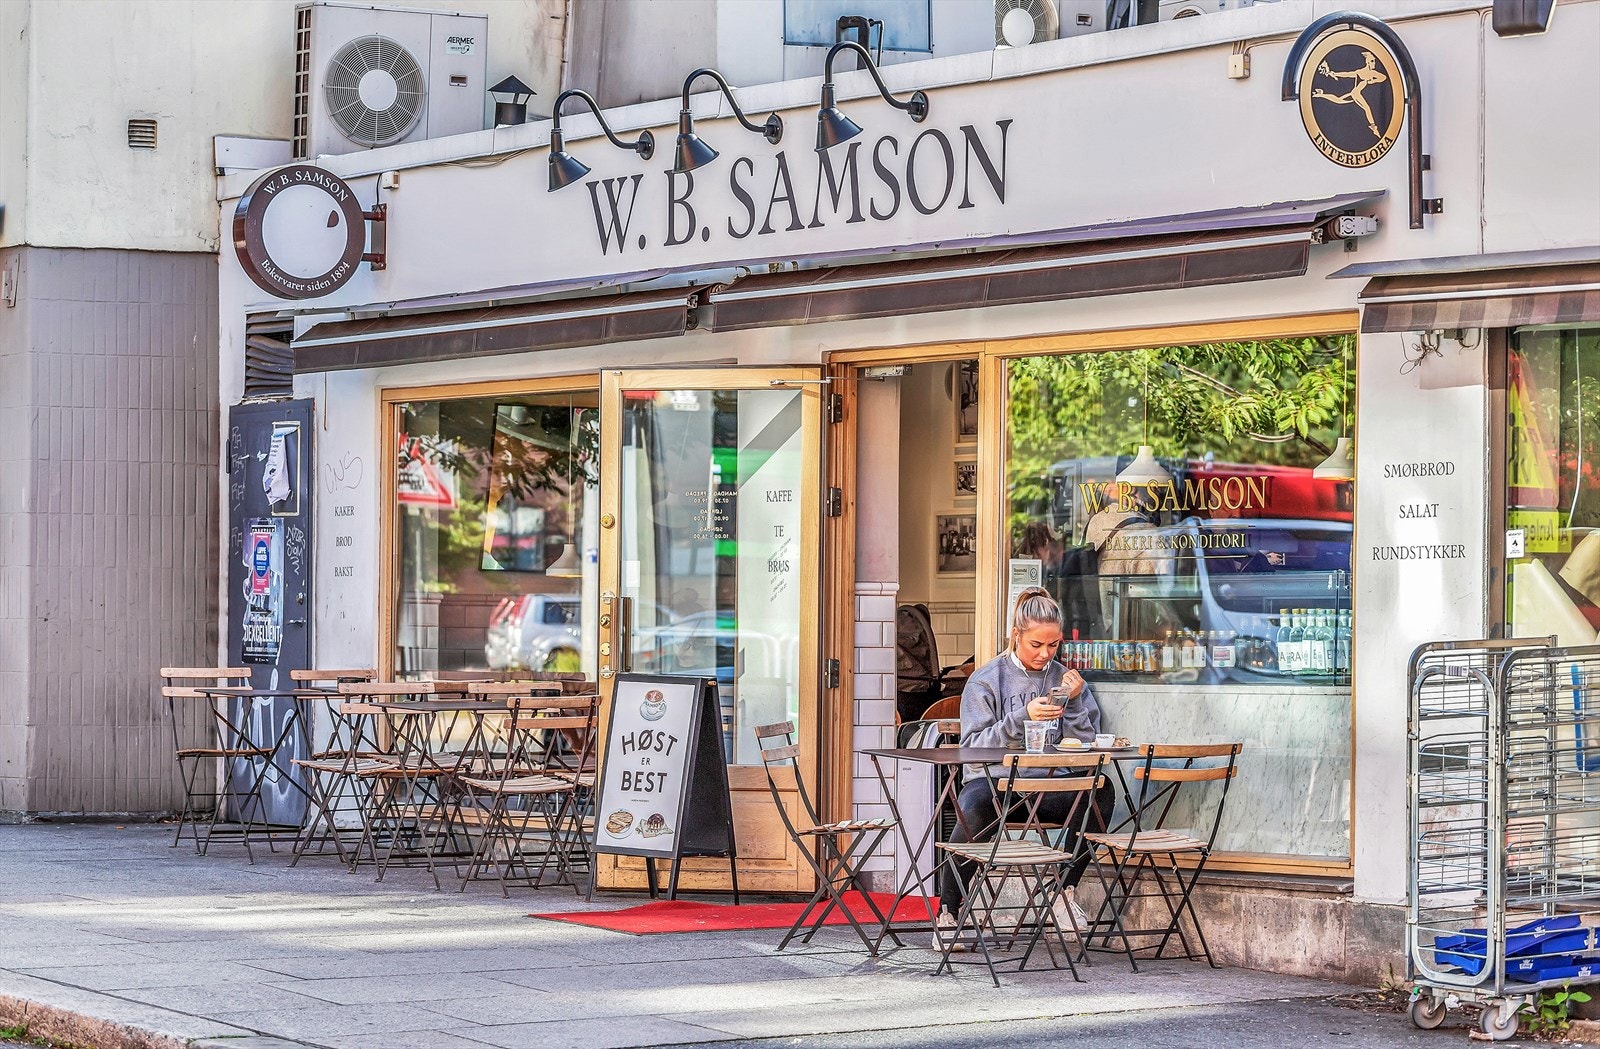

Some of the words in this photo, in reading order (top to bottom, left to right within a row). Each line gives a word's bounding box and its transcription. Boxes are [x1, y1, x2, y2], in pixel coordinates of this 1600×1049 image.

[446, 36, 474, 46] AERMEC
[1313, 132, 1394, 166] INTERFLORA
[263, 183, 280, 196] W.
[280, 174, 292, 186] B.
[295, 170, 349, 202] SAMSON
[585, 173, 647, 256] W.
[663, 168, 711, 247] B.
[727, 118, 1013, 240] SAMSON
[261, 259, 305, 292] Bakervarer
[307, 279, 331, 292] siden
[331, 261, 351, 283] 1894
[1383, 461, 1456, 478] SMØRBRØD
[766, 490, 792, 503] KAFFE
[1078, 482, 1109, 515] W.
[1116, 481, 1139, 514] B.
[1145, 475, 1269, 512] SAMSON
[334, 506, 355, 516] KAKER
[1398, 503, 1440, 519] SALAT
[774, 525, 784, 538] TE
[1105, 535, 1153, 550] BAKERI
[1156, 534, 1168, 549] &
[1171, 533, 1246, 549] KONDITORI
[1372, 544, 1466, 561] RUNDSTYKKER
[334, 566, 354, 577] BAKST
[768, 560, 790, 573] BRUS
[620, 729, 678, 756] HØST
[640, 757, 650, 766] ER
[620, 770, 668, 794] BEST
